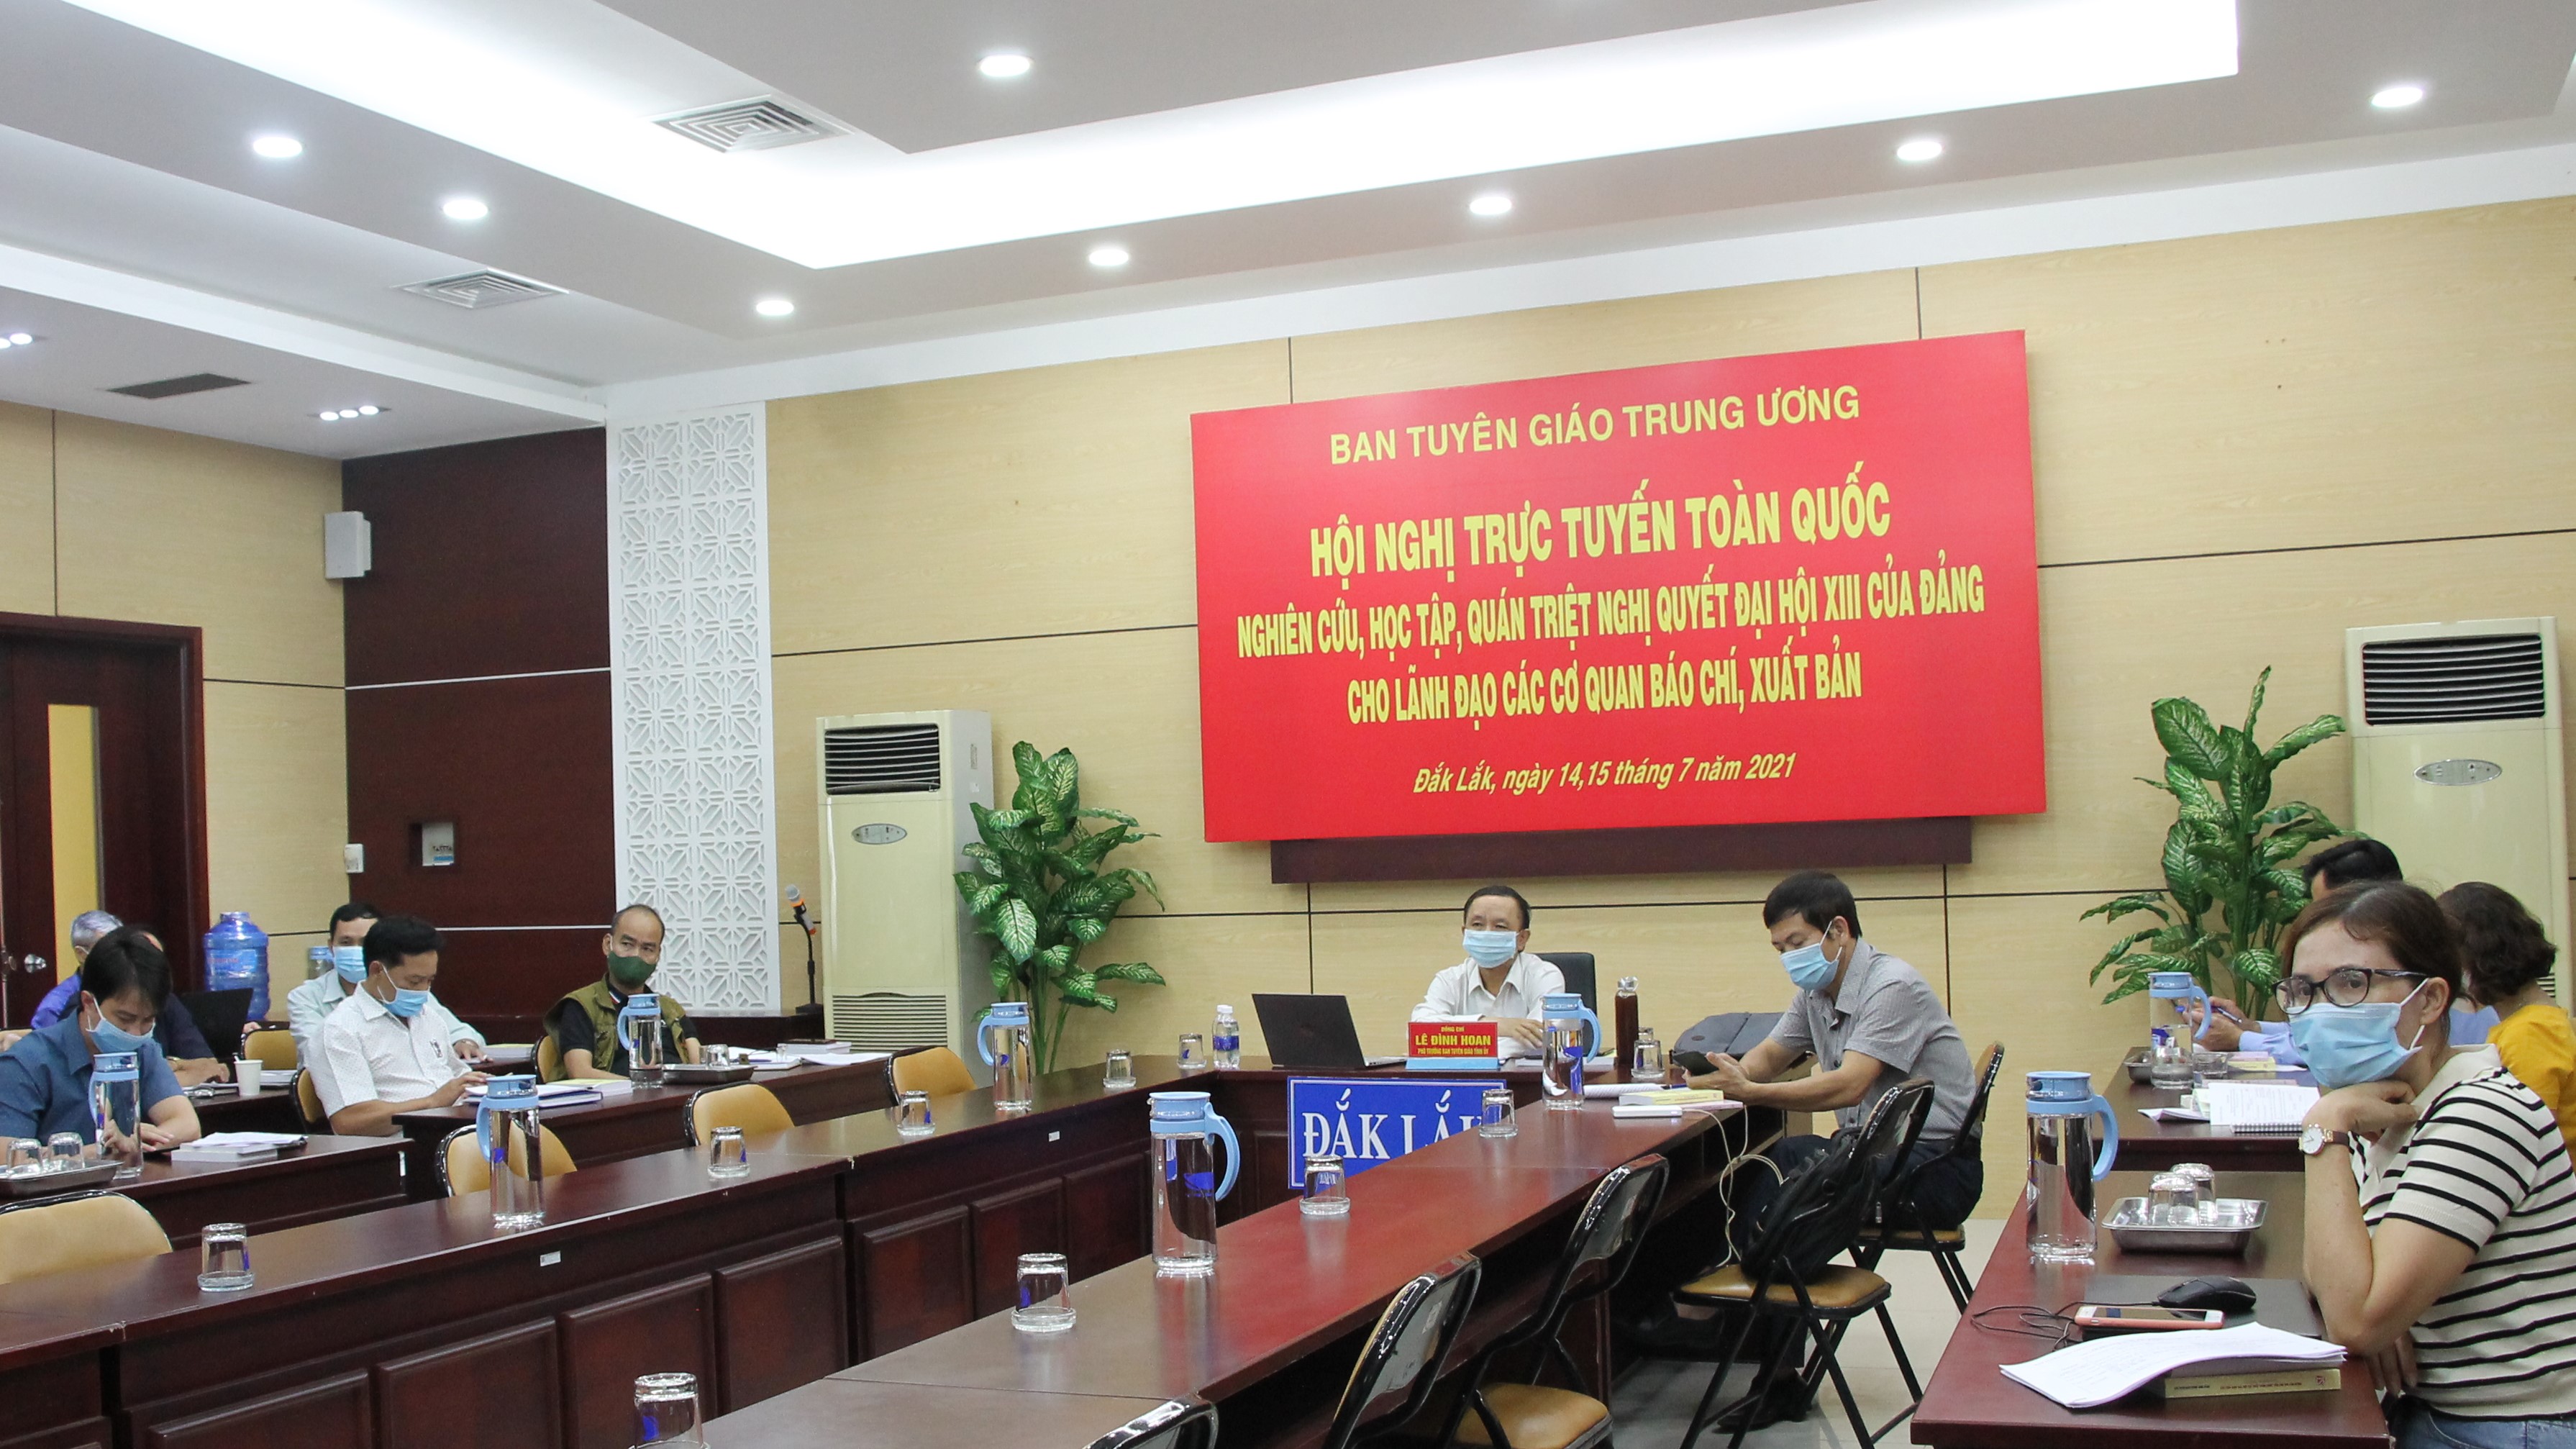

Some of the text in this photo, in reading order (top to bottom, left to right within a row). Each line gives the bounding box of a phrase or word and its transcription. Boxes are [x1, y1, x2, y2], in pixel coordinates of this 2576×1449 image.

[1331, 386, 1859, 464] BAN TUYÊN GIÁO TRUNG ƯƠNG
[1311, 461, 1890, 590] HỘI NGHỊ TRỰC TUYẾN TOÀN QUỐC
[1238, 550, 1984, 661] NGHIÊN CỨU, HỌC TẬP, QUÁN TRIỆT NGHỊ QUYẾT ĐẠI HỘI XIII CỦA ĐẢNG
[1348, 635, 1861, 730] CHO LÃNH ĐẠO CÁC CƠ QUAN BÁO CHÍ, XUẤT BẢN
[1414, 753, 1796, 795] Đắk Lắk, ngày 14,15 tháng 7 năm 2021
[1415, 1033, 1491, 1045] LÊ ĐÌNH HOAN
[1301, 1088, 1391, 1160] ĐẮK
